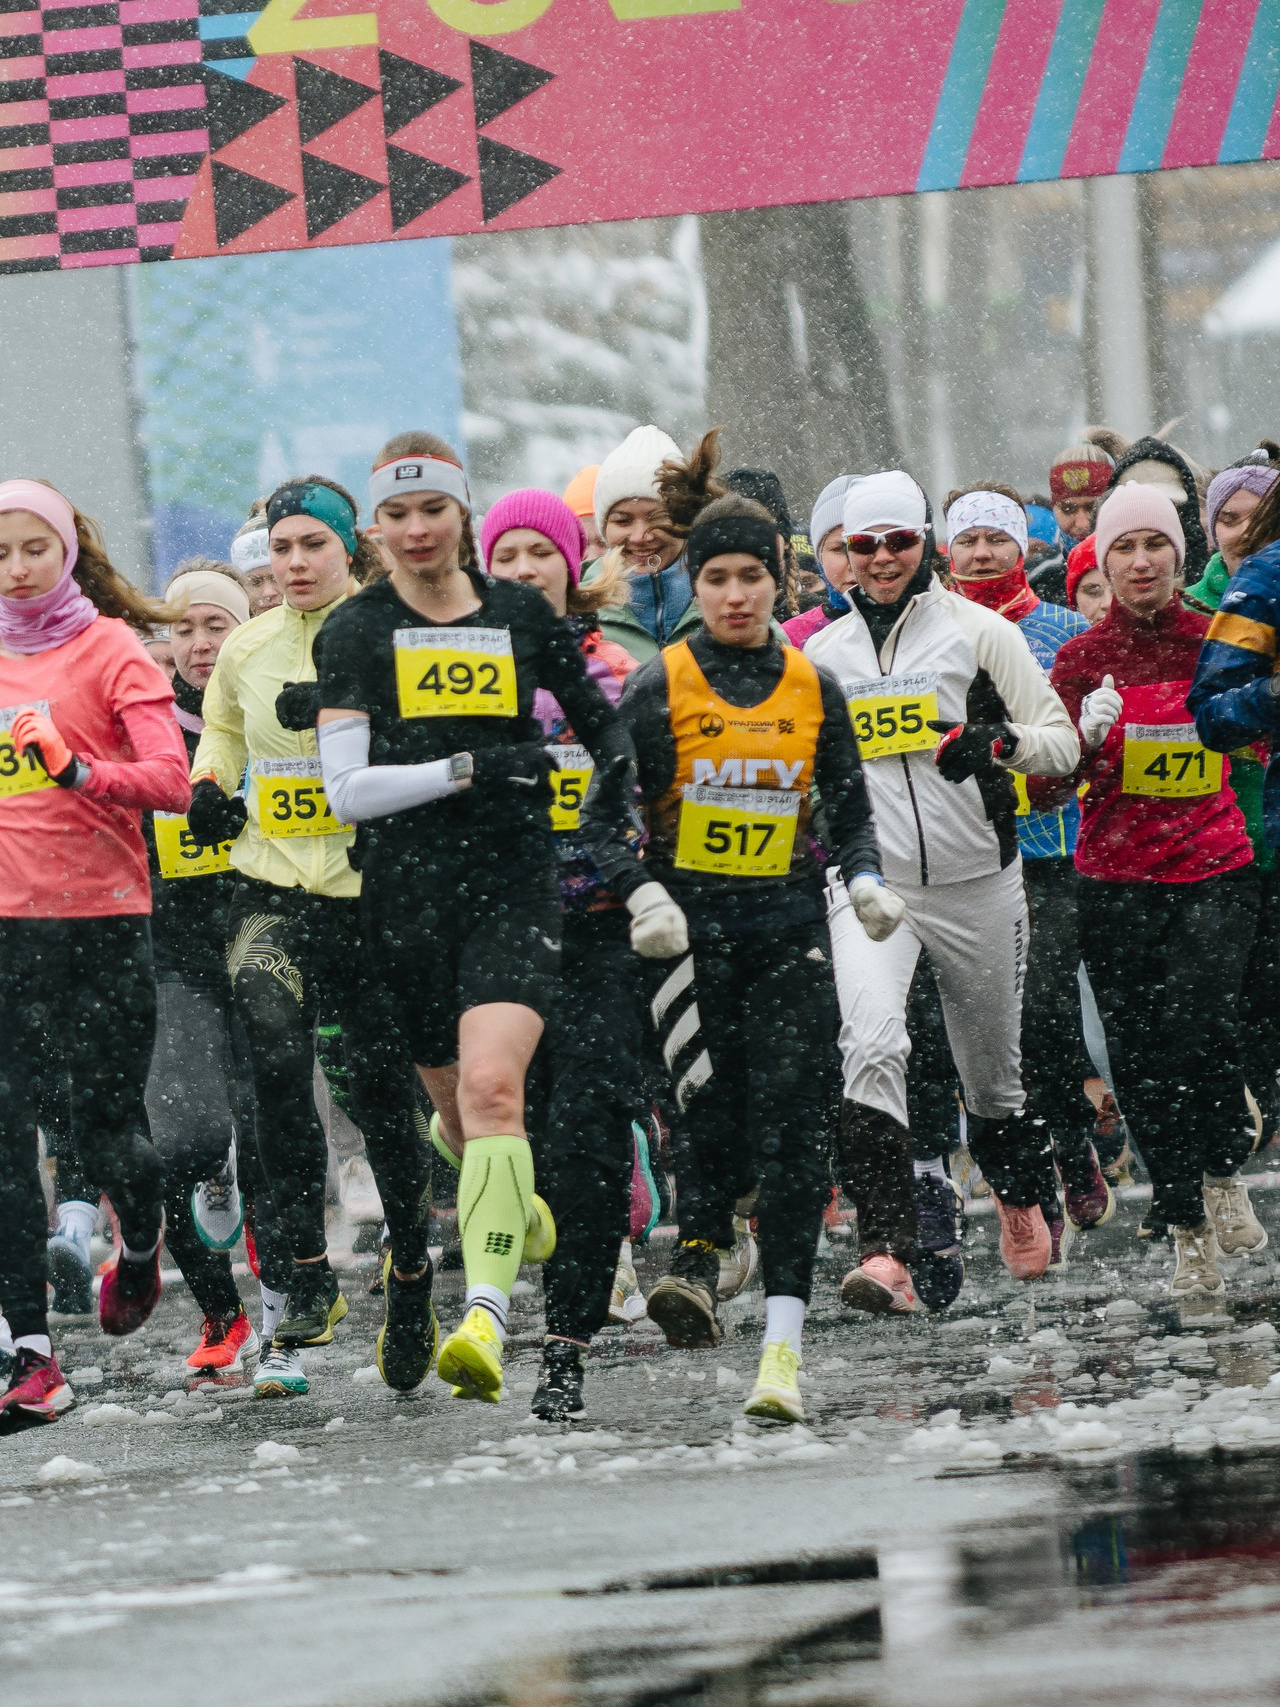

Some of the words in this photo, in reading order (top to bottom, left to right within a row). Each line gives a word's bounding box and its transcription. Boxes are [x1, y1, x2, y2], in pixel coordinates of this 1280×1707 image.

[417, 661, 502, 695] 492
[902, 676, 928, 686] ЭТАП
[854, 702, 924, 743] 355
[692, 758, 806, 789] МГУ
[1143, 749, 1206, 781] 471
[704, 819, 778, 857] 517
